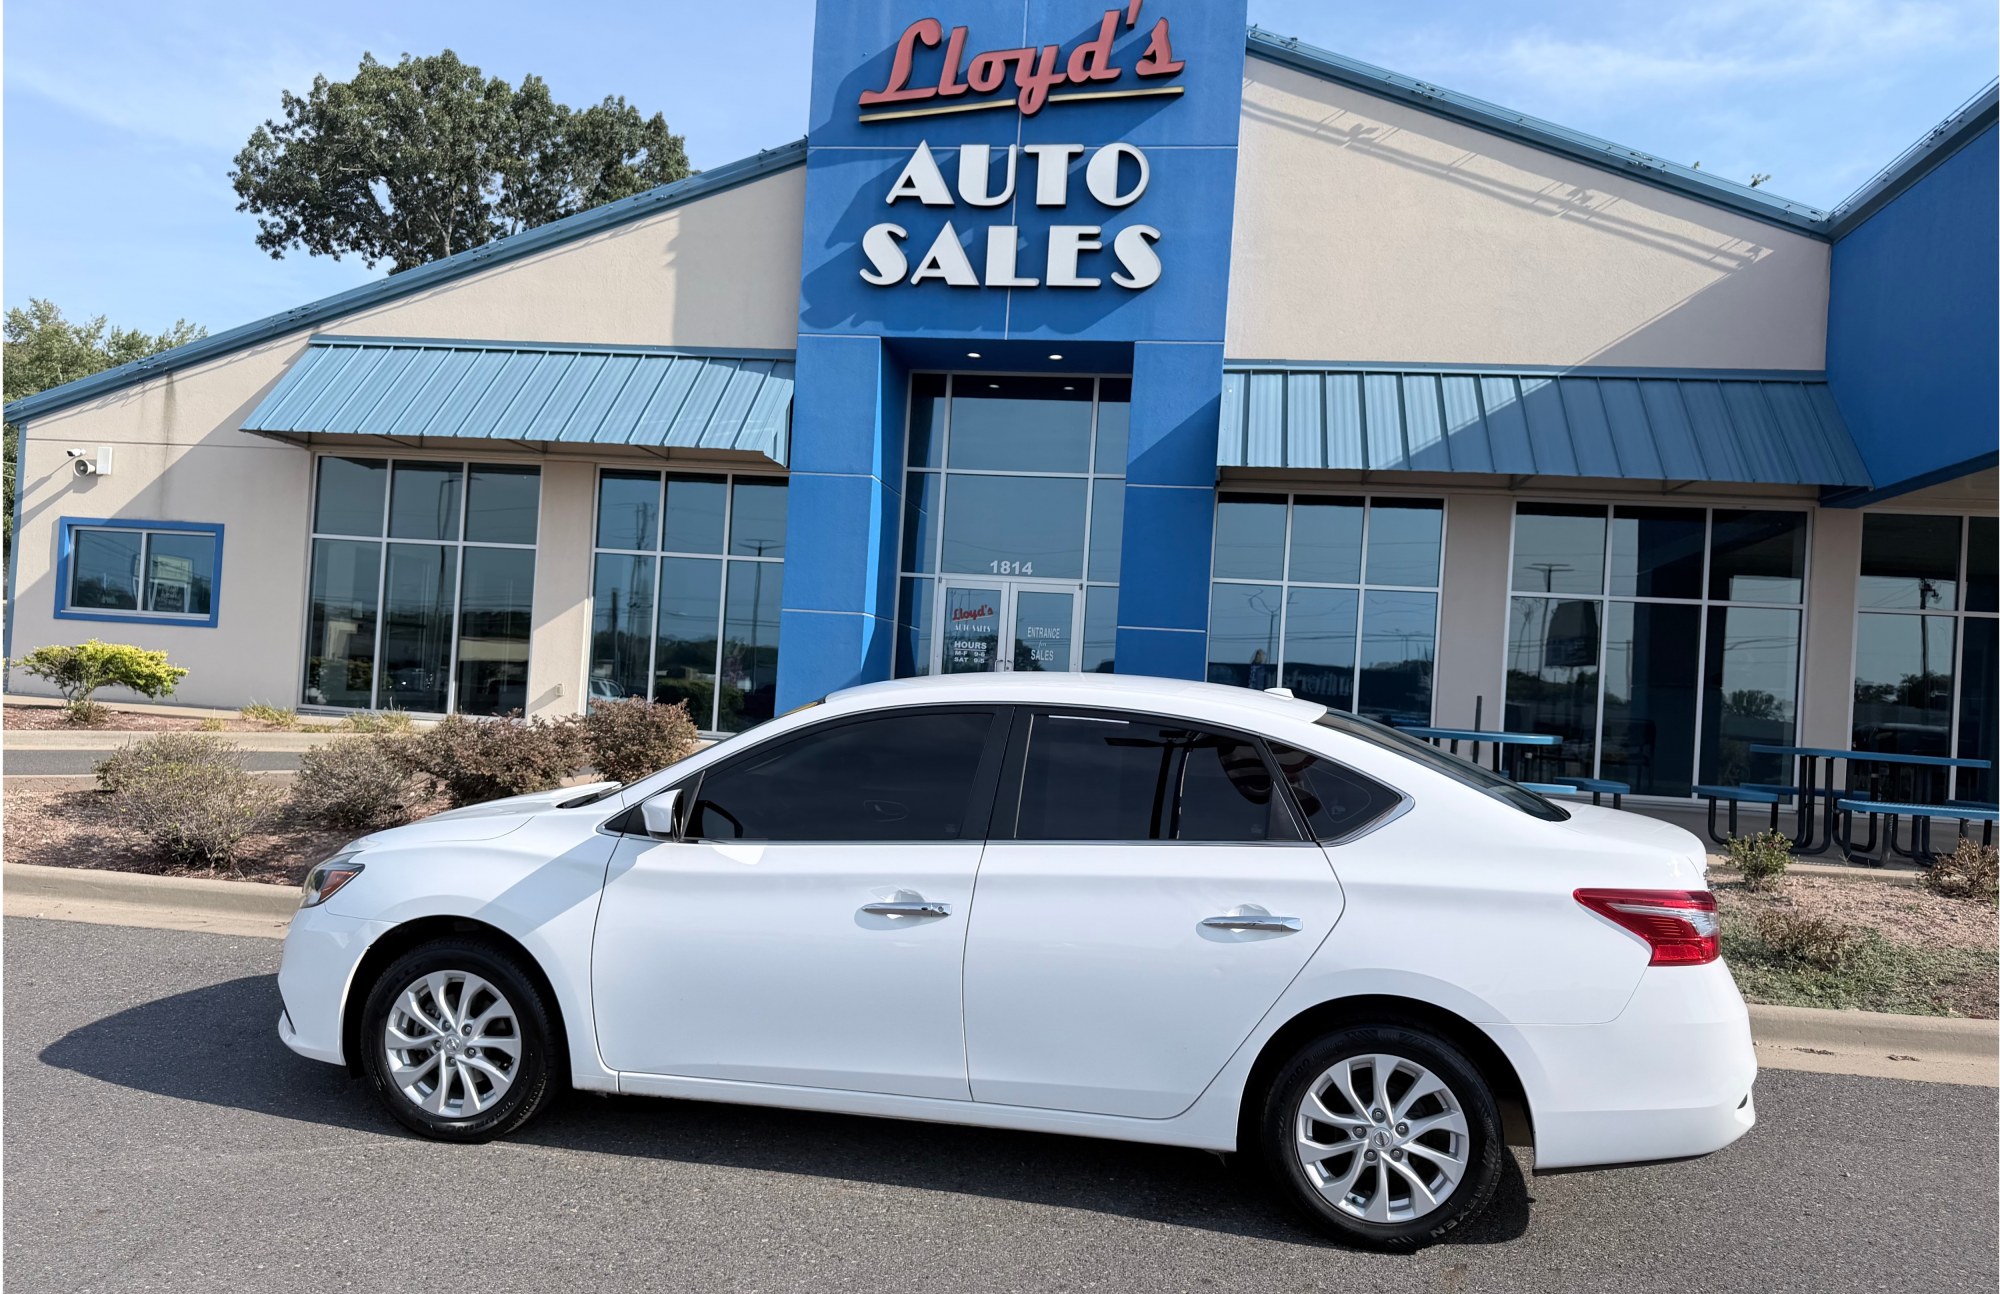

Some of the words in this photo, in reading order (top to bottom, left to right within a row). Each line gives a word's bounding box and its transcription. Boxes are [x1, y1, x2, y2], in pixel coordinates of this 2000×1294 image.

[859, 0, 1186, 116] Lloyd's
[885, 139, 1151, 208] AUTO
[859, 220, 1163, 289] SALES
[990, 560, 1033, 575] 1814
[953, 604, 994, 621] Lloyd's
[1027, 626, 1060, 639] ENTRANCE
[954, 640, 987, 650] HOURS
[1030, 649, 1054, 661] SALES
